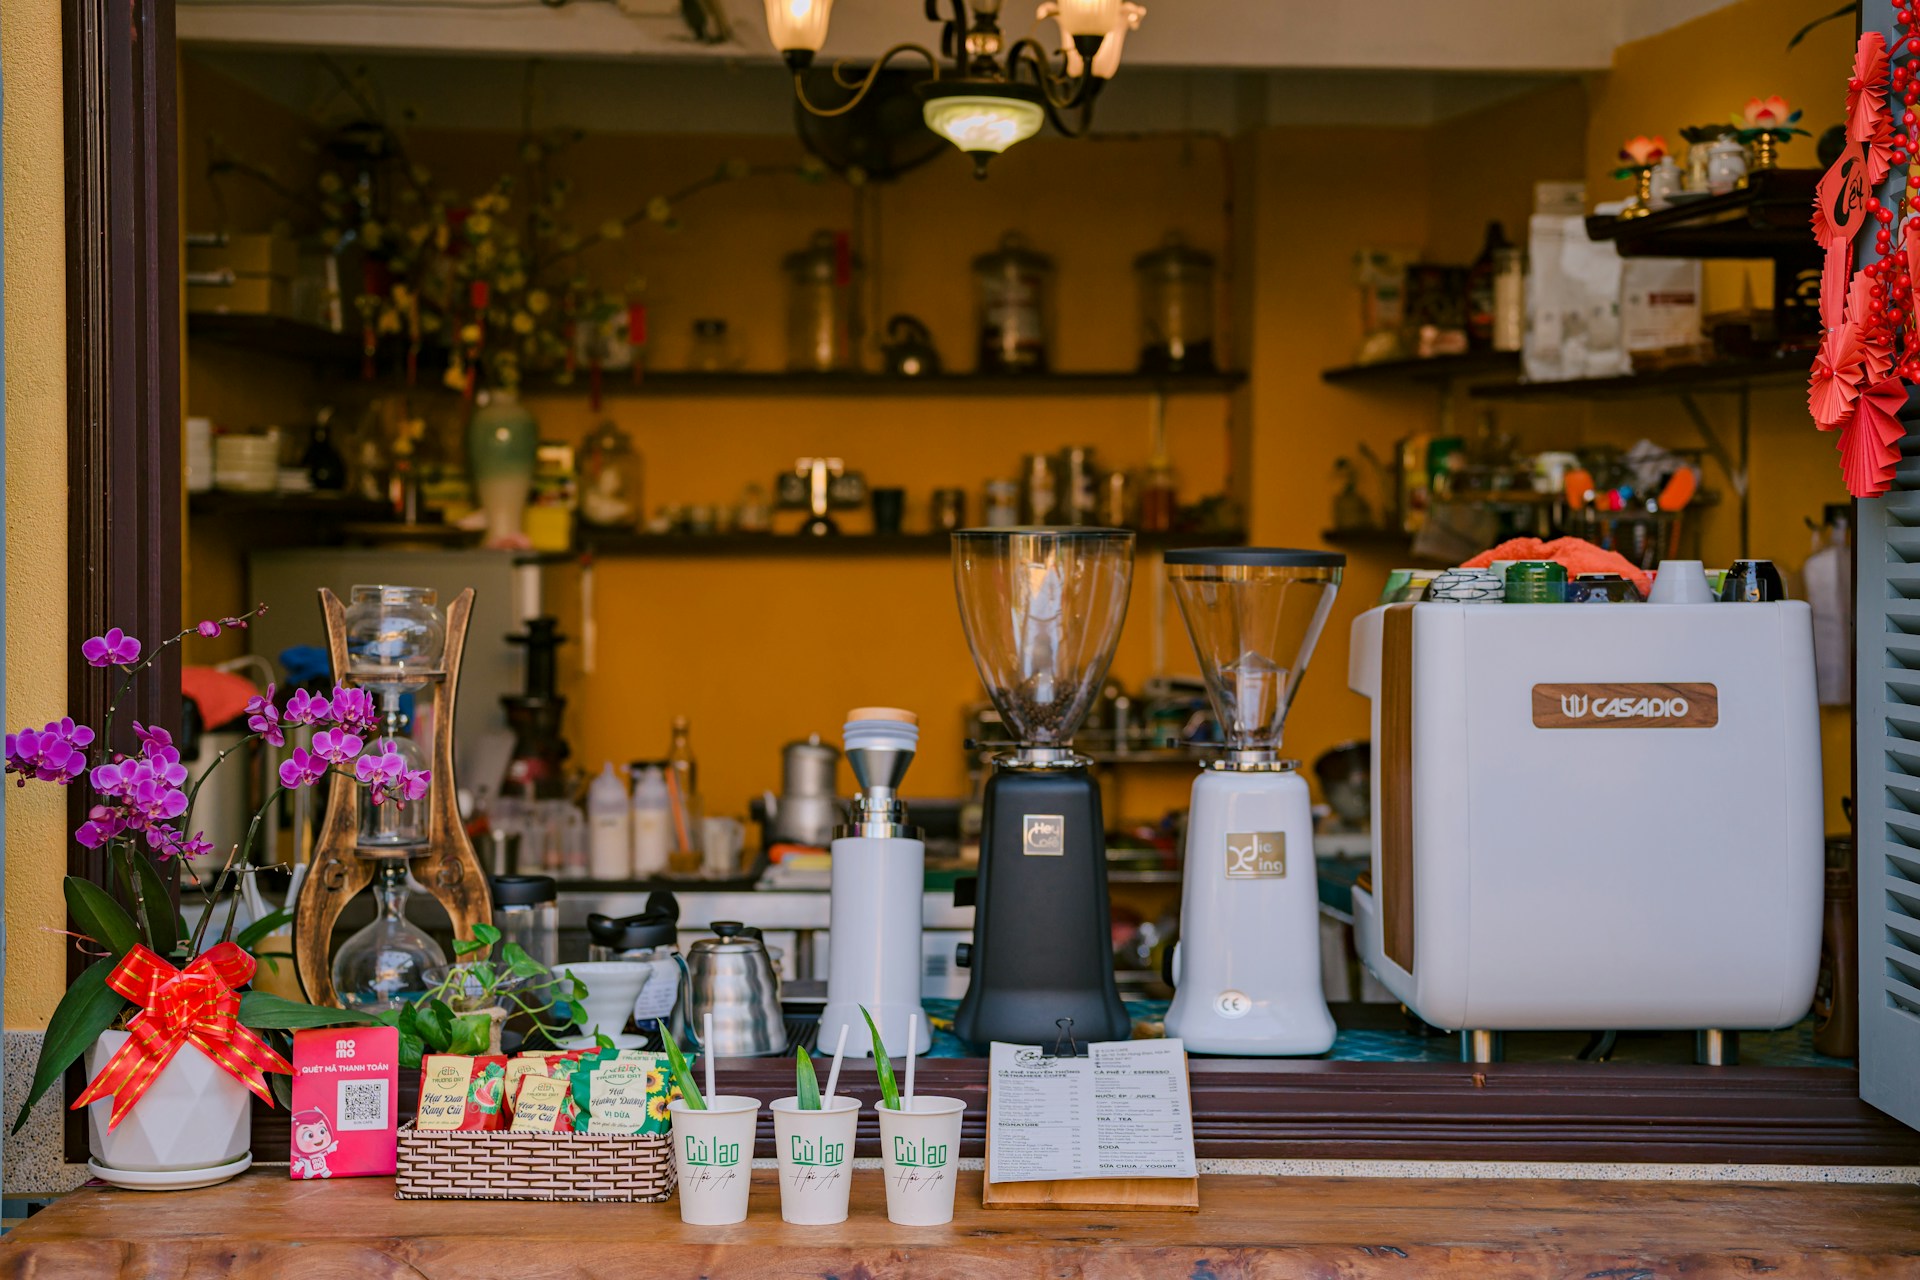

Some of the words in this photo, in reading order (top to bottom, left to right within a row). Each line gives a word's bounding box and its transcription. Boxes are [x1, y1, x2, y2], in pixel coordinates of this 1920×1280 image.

[1591, 697, 1688, 717] CASADIO
[1034, 822, 1060, 836] Hey
[302, 1064, 323, 1073] QUÉT
[325, 1064, 337, 1072] MÃ
[339, 1064, 365, 1072] THANH
[367, 1063, 388, 1071] TOÁN
[424, 1093, 442, 1104] Hạt
[421, 1105, 445, 1117] Rang
[686, 1136, 707, 1161] Cù
[714, 1136, 739, 1164] lao
[792, 1136, 813, 1161] Cù
[820, 1136, 844, 1163] lao
[895, 1136, 916, 1162] Cù
[922, 1138, 947, 1164] lao
